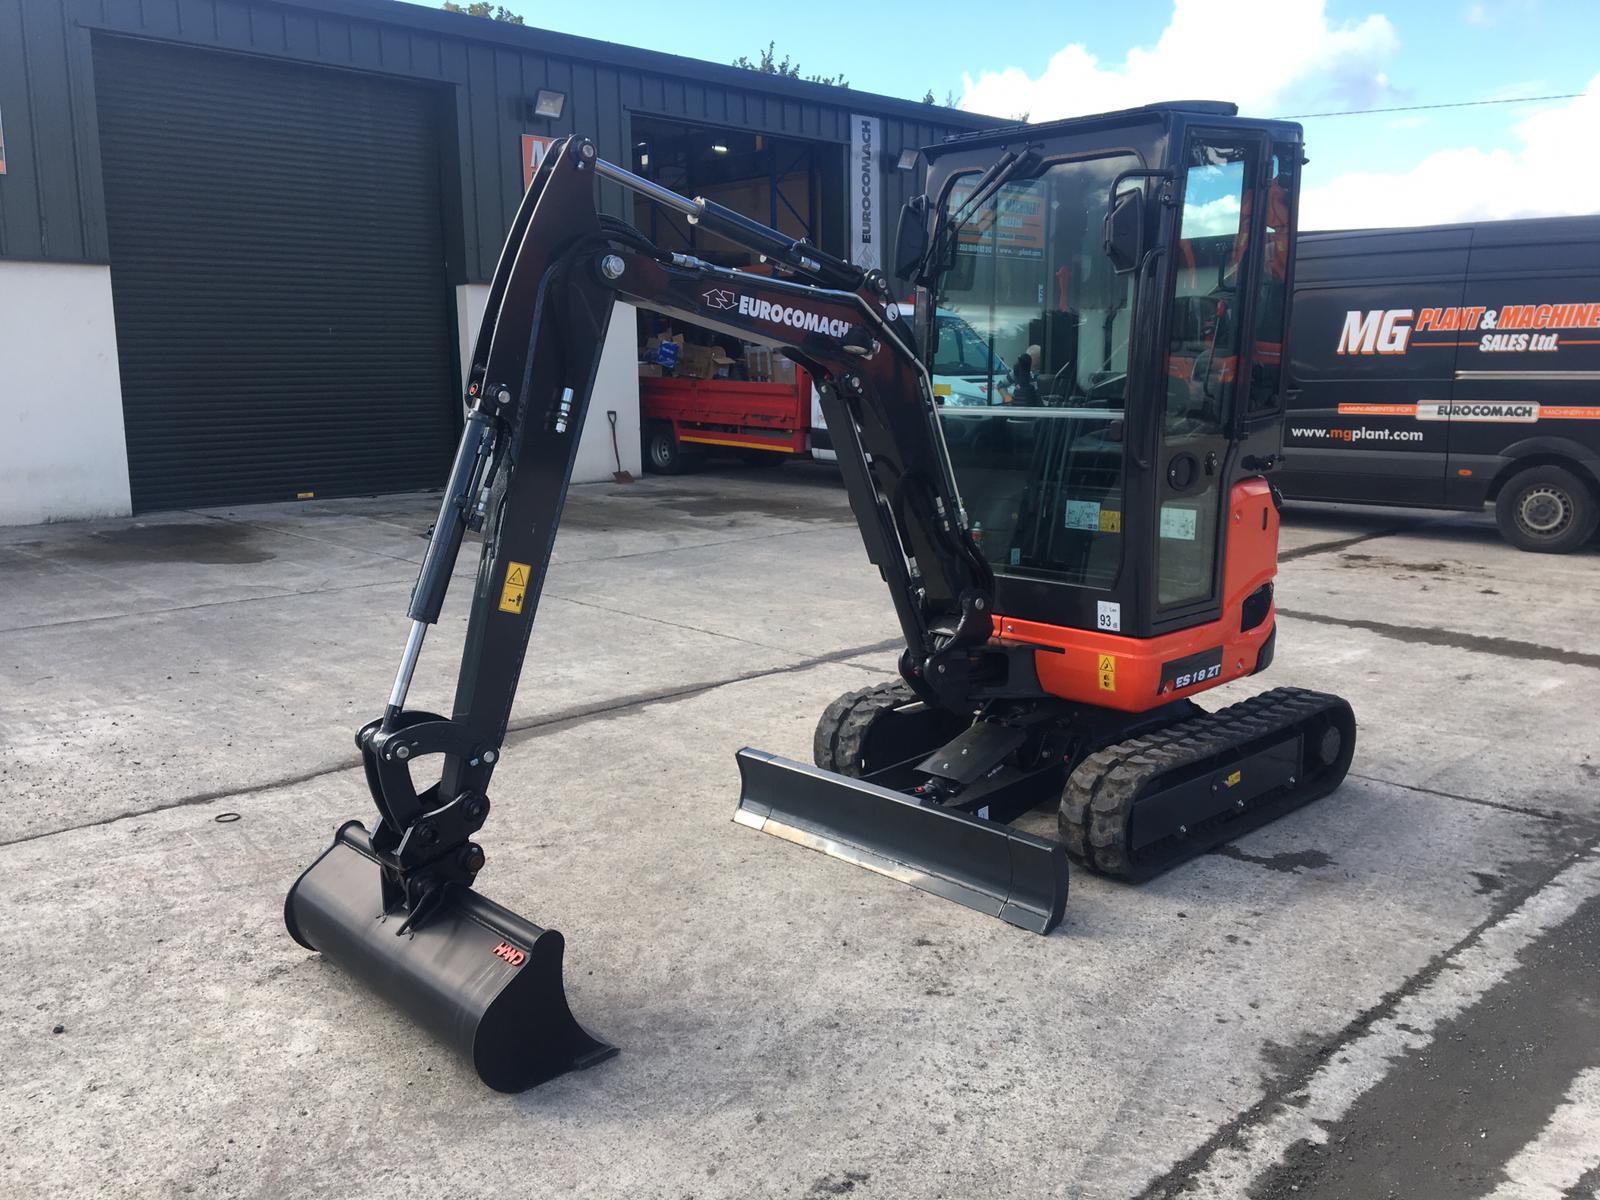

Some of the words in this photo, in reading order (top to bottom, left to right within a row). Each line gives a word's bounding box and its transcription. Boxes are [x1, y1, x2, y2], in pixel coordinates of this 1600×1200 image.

[861, 119, 871, 244] EUROCOMACH
[738, 295, 849, 338] EUROCOMACH
[1337, 309, 1414, 355] MG
[1479, 334, 1528, 352] SALES
[1528, 333, 1559, 351] Ltd.
[1437, 405, 1533, 417] EUROCOMACH
[1292, 427, 1423, 442] www.mgplant.com
[1100, 614, 1111, 627] 93
[1176, 675, 1190, 688] ES
[1192, 668, 1206, 682] 18
[1207, 664, 1221, 678] ZT
